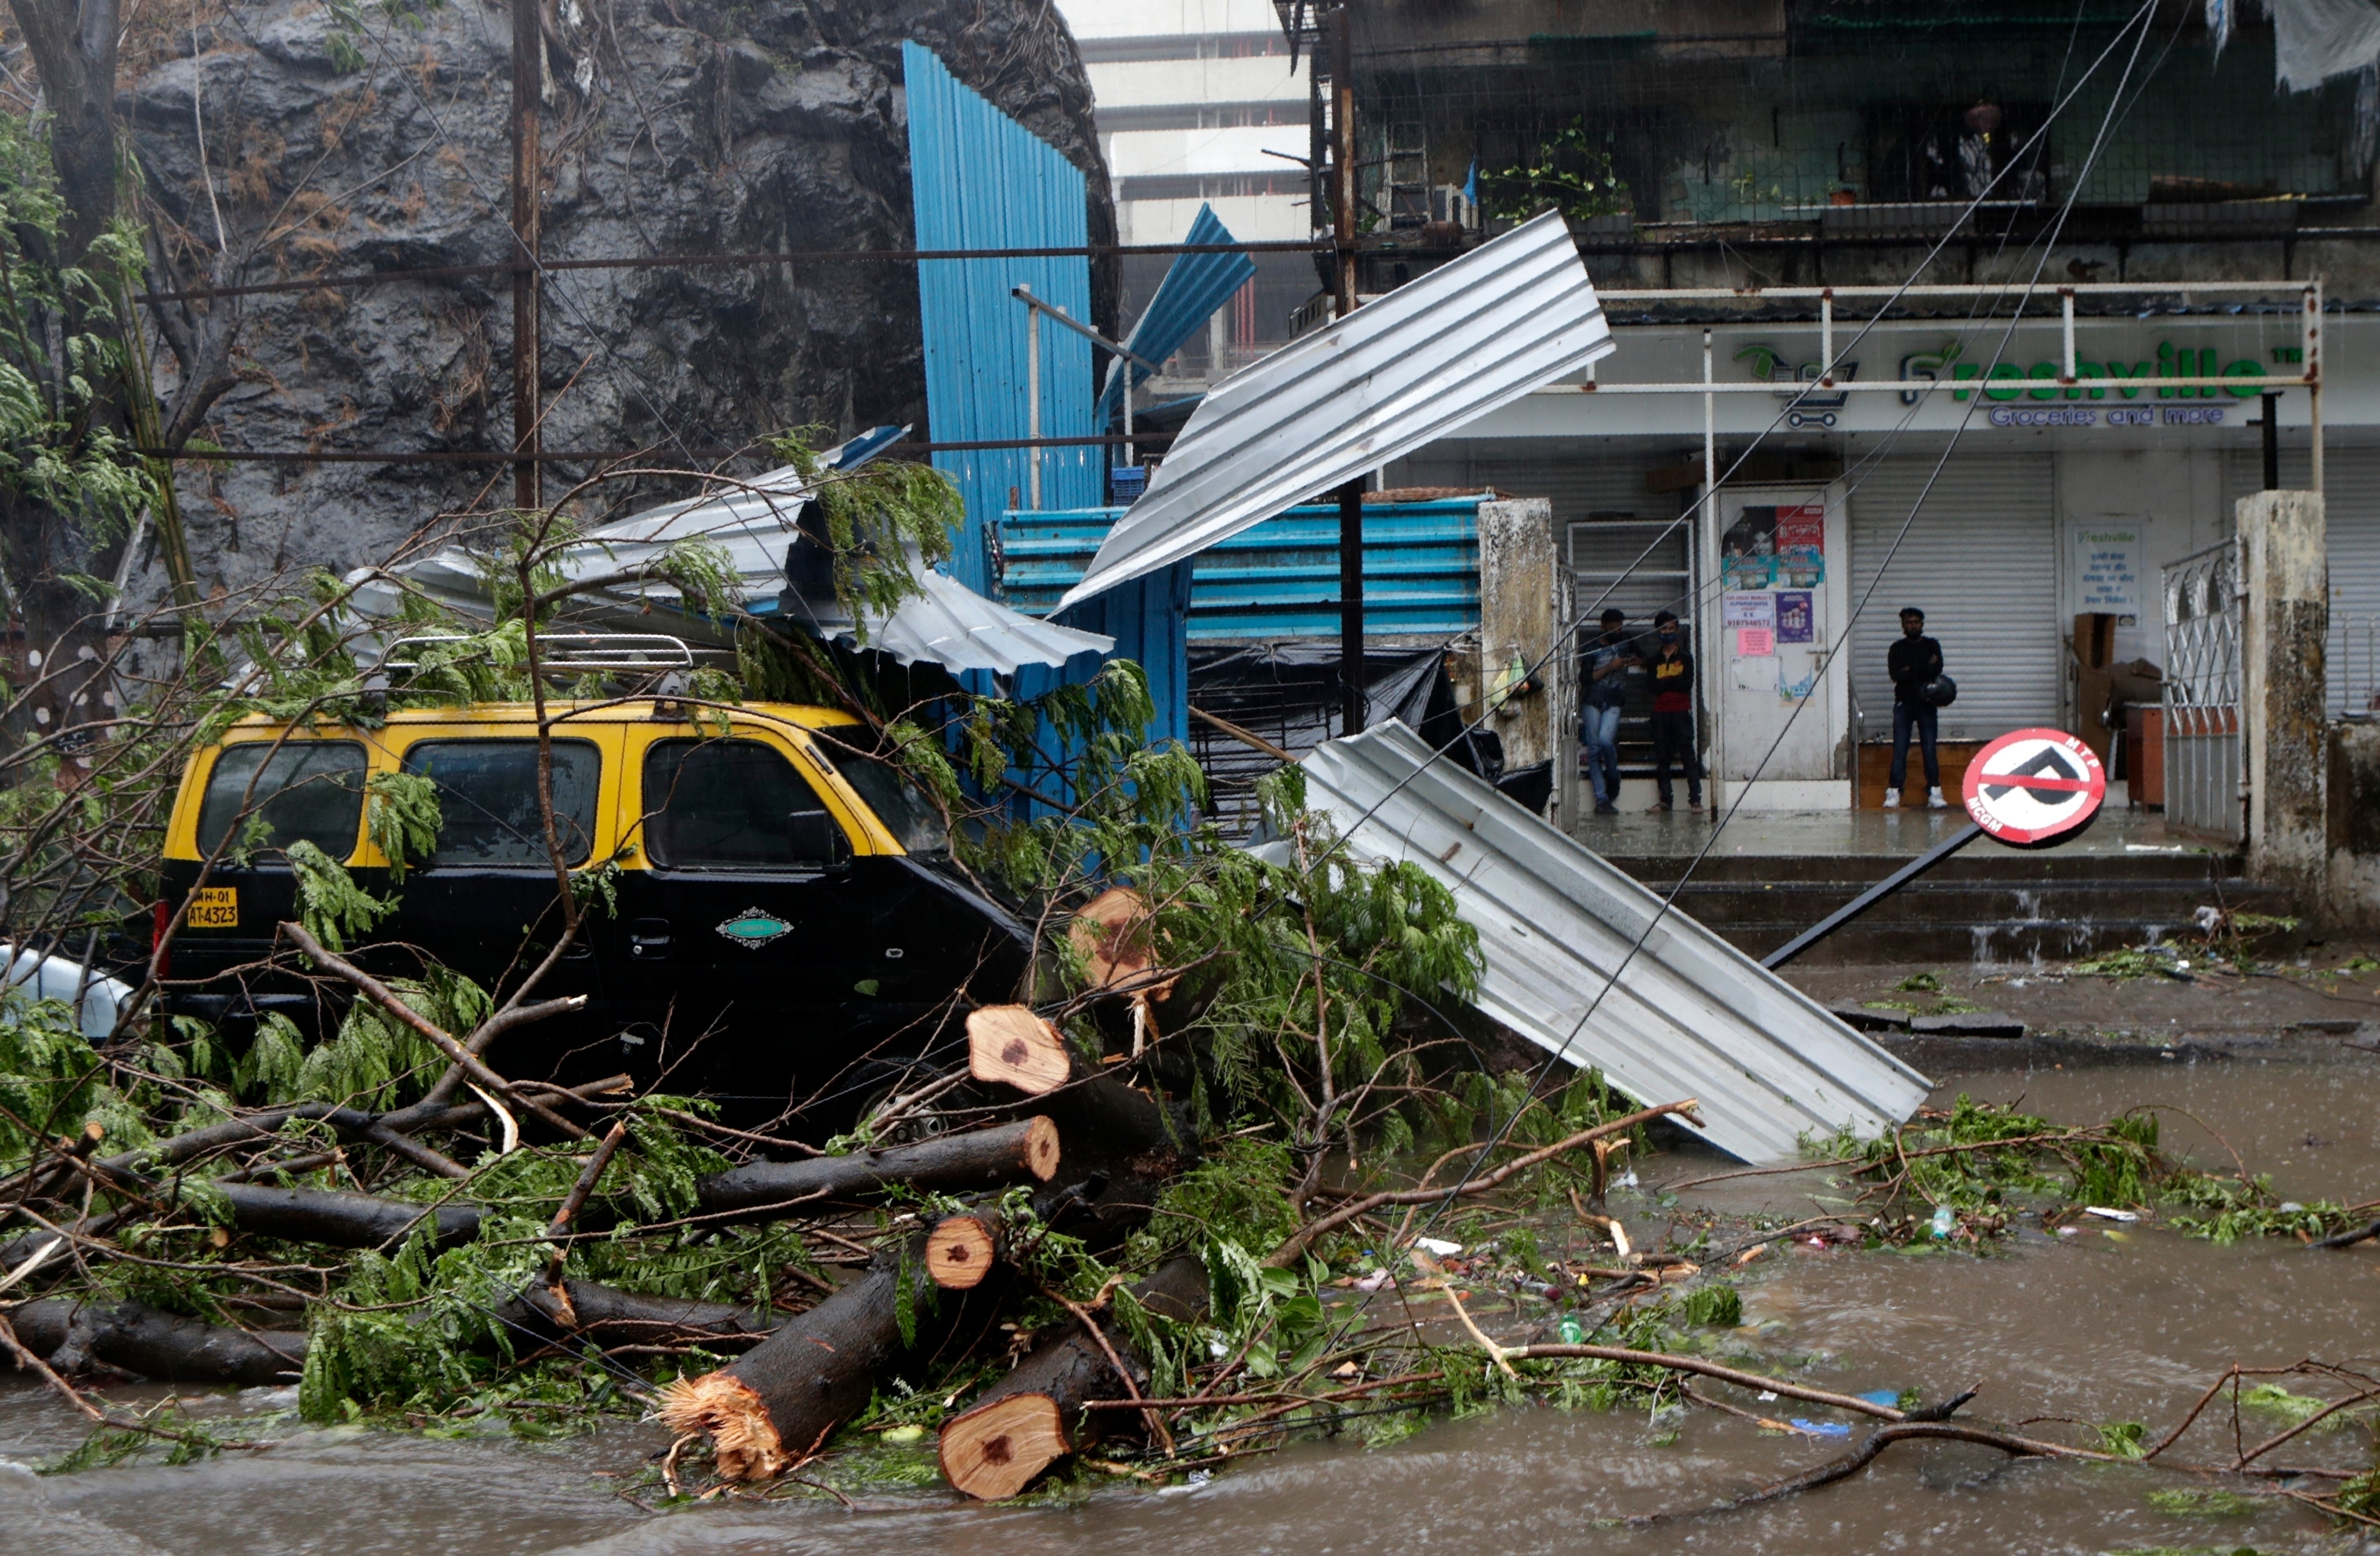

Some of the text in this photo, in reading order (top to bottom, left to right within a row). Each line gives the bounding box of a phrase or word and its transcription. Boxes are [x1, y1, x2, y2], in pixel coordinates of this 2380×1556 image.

[1900, 341, 2266, 405] Freshville
[1990, 405, 2224, 426] Groceries and more
[1967, 796, 2004, 833] MCGM
